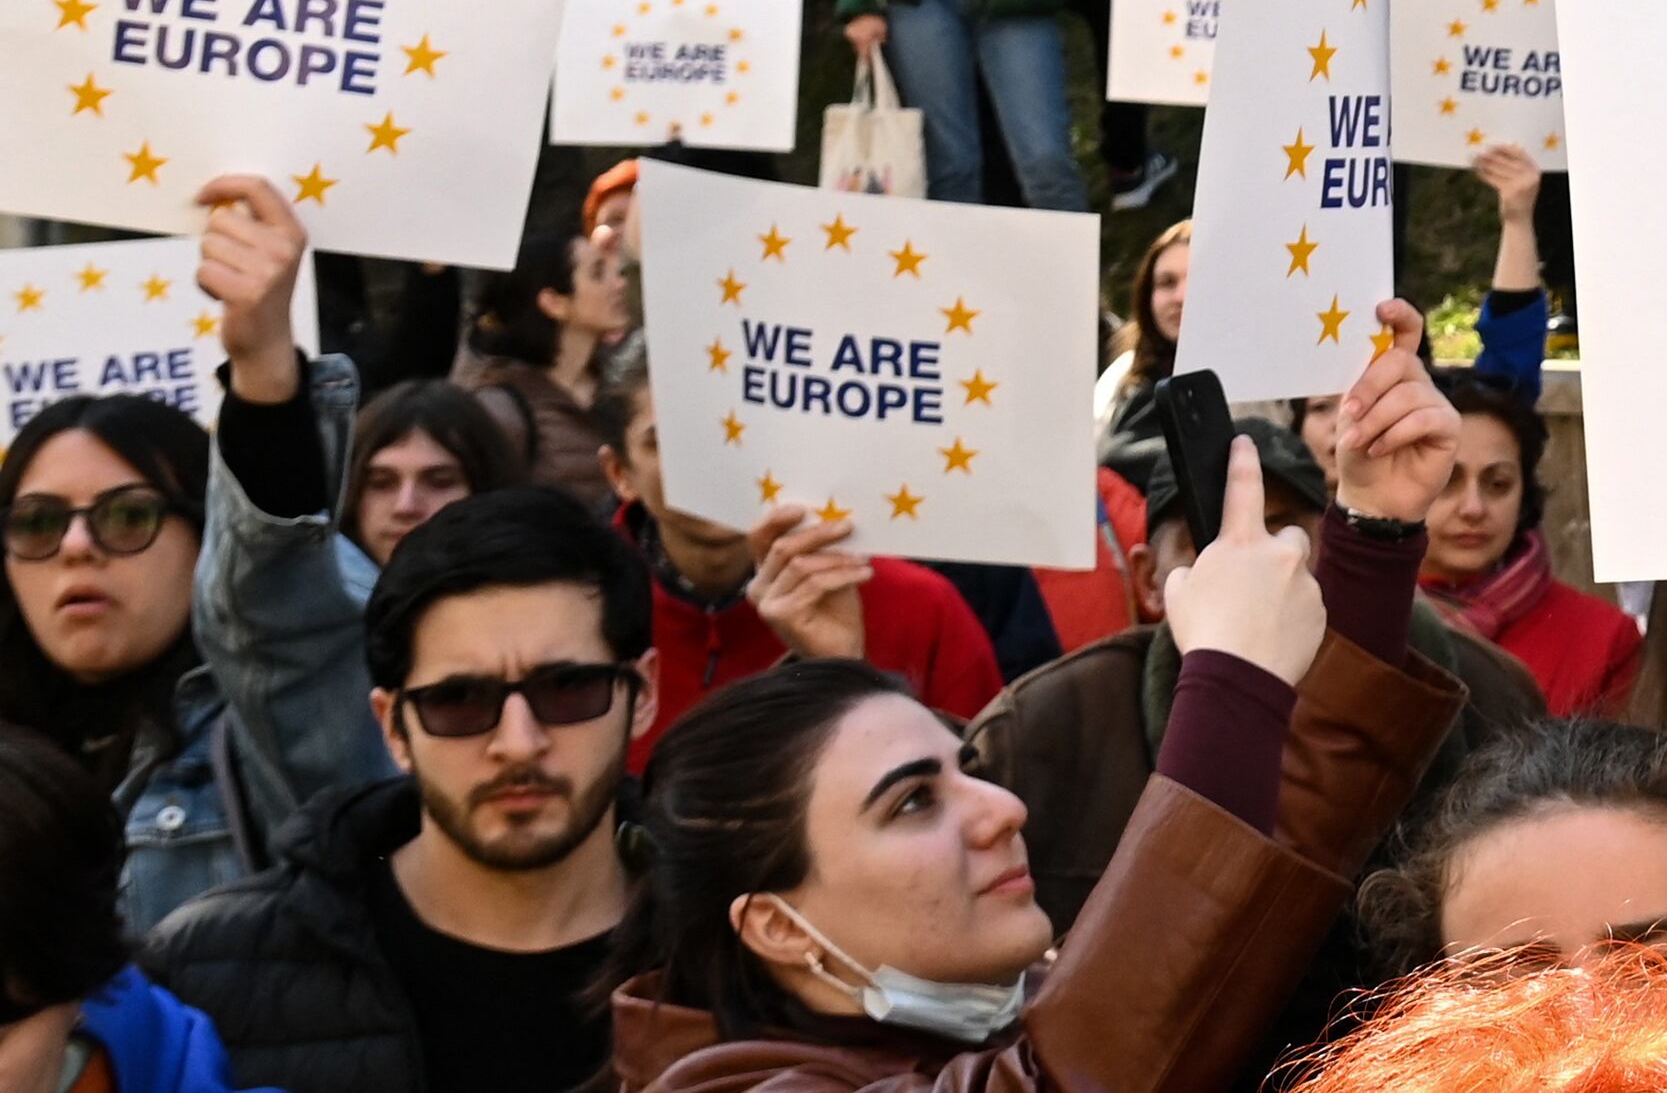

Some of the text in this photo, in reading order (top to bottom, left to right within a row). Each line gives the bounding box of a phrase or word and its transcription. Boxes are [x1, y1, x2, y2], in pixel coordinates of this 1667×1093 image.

[112, 19, 380, 96] EUROPE
[625, 43, 726, 62] WE ARE
[625, 63, 725, 83] EUROPE
[1463, 44, 1560, 74] WE AR
[1460, 70, 1562, 97] EUROP
[1328, 95, 1381, 148] WE
[1320, 157, 1393, 209] EUR
[5, 349, 193, 393] WE ARE
[742, 319, 941, 381] WE ARE
[743, 365, 943, 425] EUROPE
